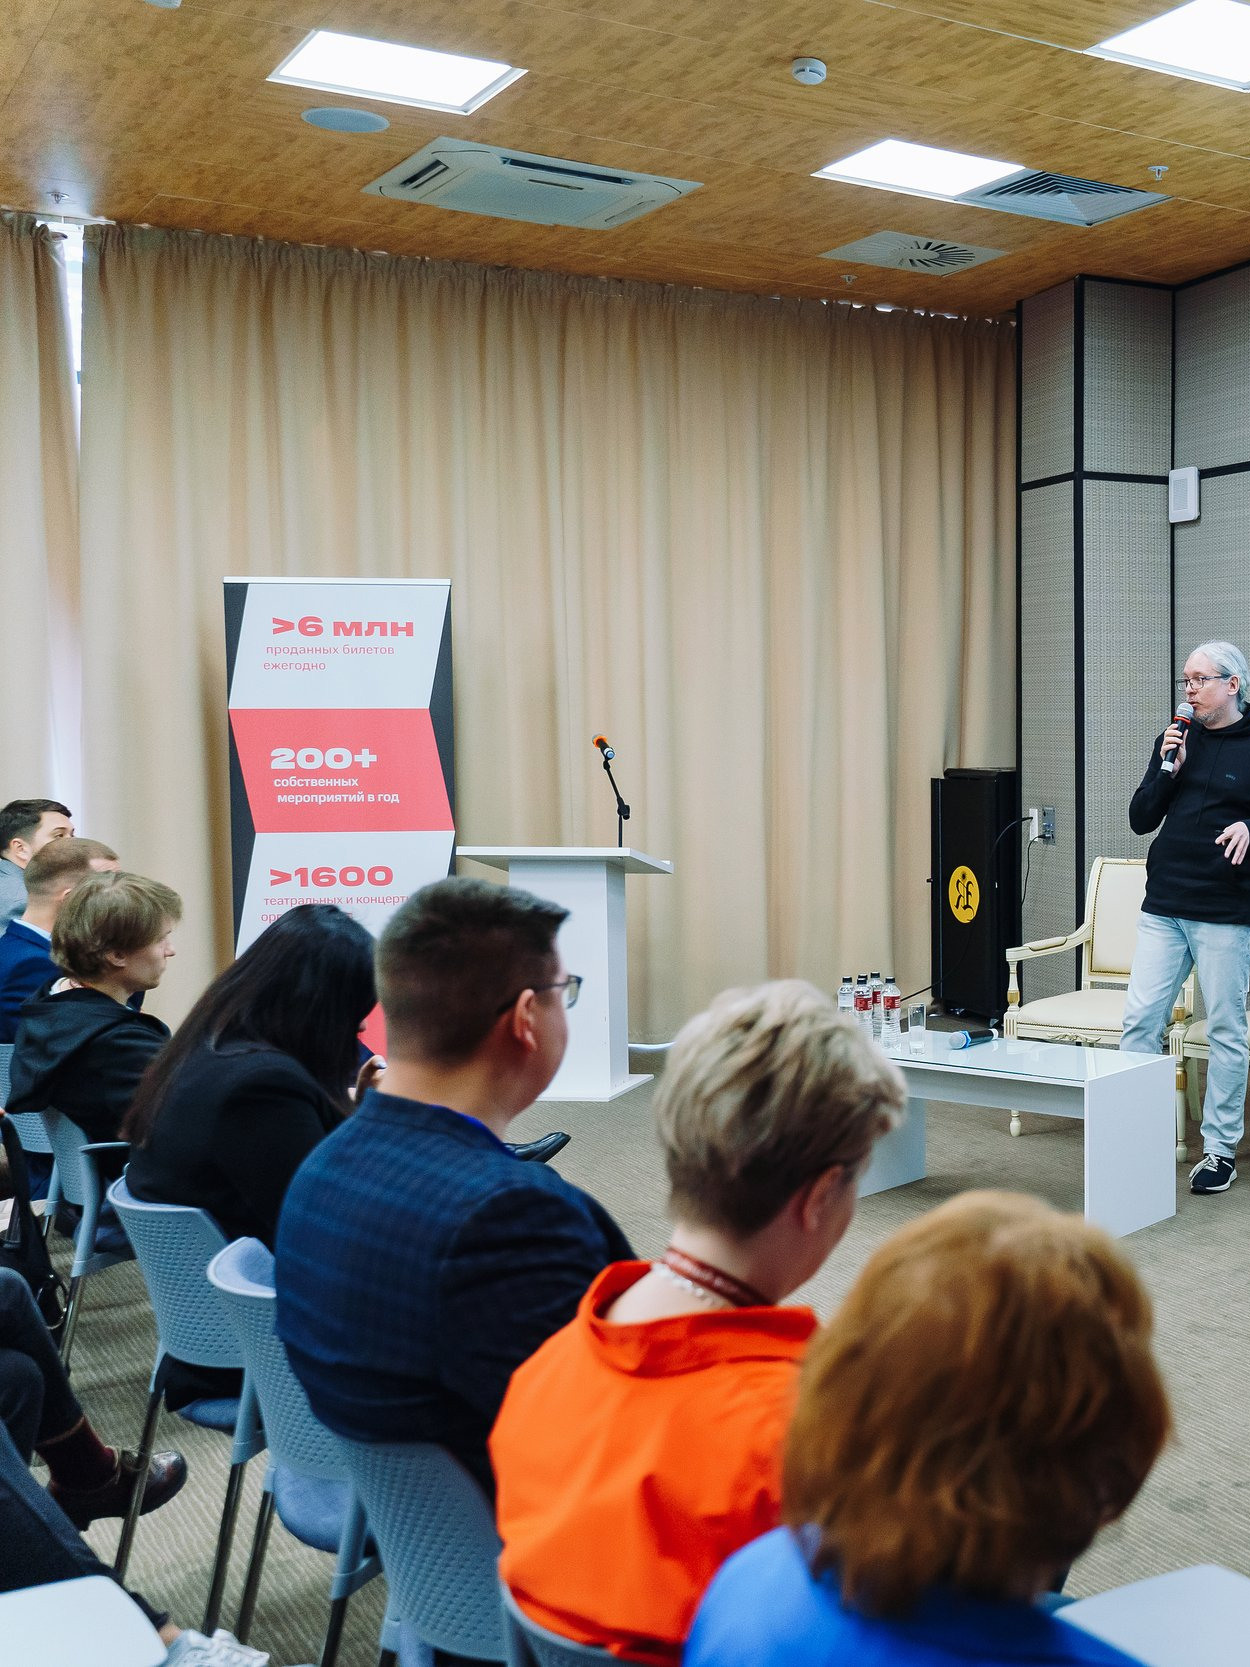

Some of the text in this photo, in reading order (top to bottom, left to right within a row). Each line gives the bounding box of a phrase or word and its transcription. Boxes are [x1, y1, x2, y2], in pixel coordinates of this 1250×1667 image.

[272, 616, 414, 637] >6 млн
[266, 643, 395, 658] проданных билетов
[263, 661, 326, 673] ежегодно
[270, 747, 378, 770] 200+
[274, 775, 359, 788] собственных
[277, 790, 399, 805] мероприятий в год
[269, 865, 394, 888] >1600
[264, 896, 344, 907] театральных
[356, 895, 409, 906] концерт
